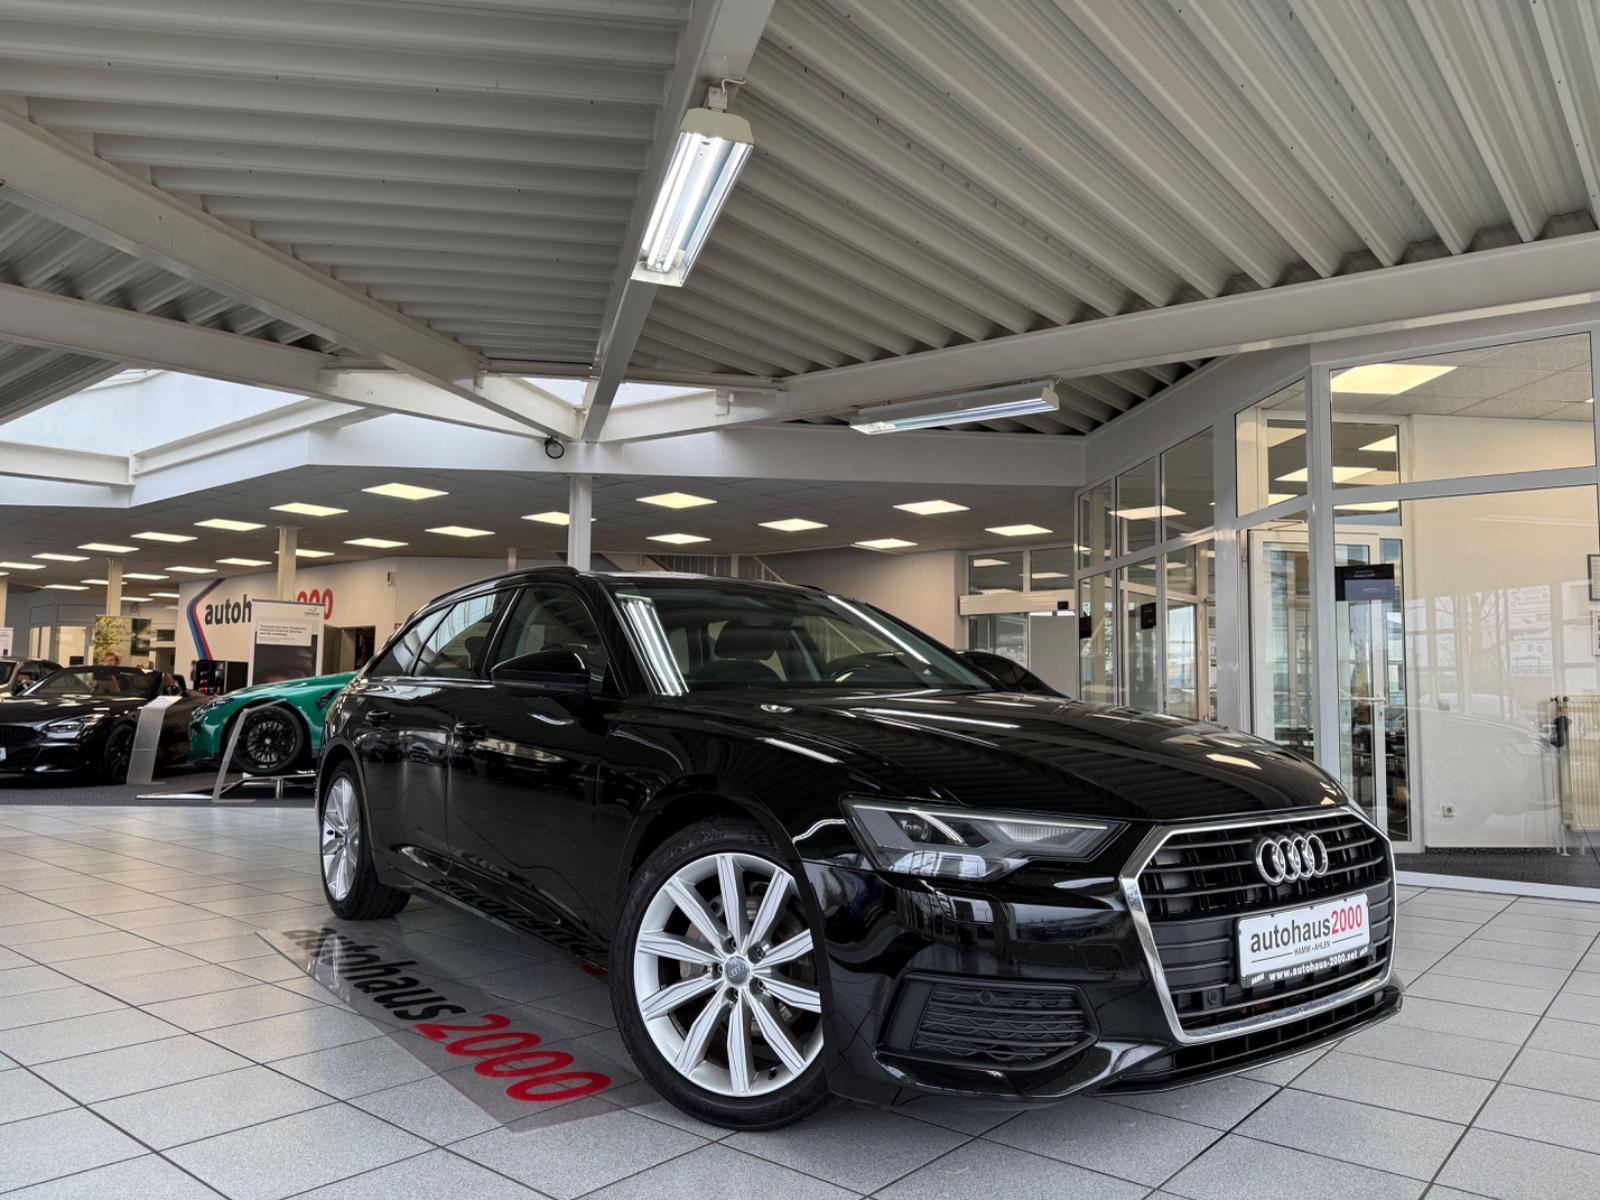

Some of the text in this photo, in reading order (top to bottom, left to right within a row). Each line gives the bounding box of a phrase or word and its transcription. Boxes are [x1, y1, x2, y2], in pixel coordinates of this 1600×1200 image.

[1250, 904, 1363, 953] autohaus2000
[1268, 950, 1358, 982] www.autohaus-2000.net
[282, 927, 612, 1103] autohaus2000
